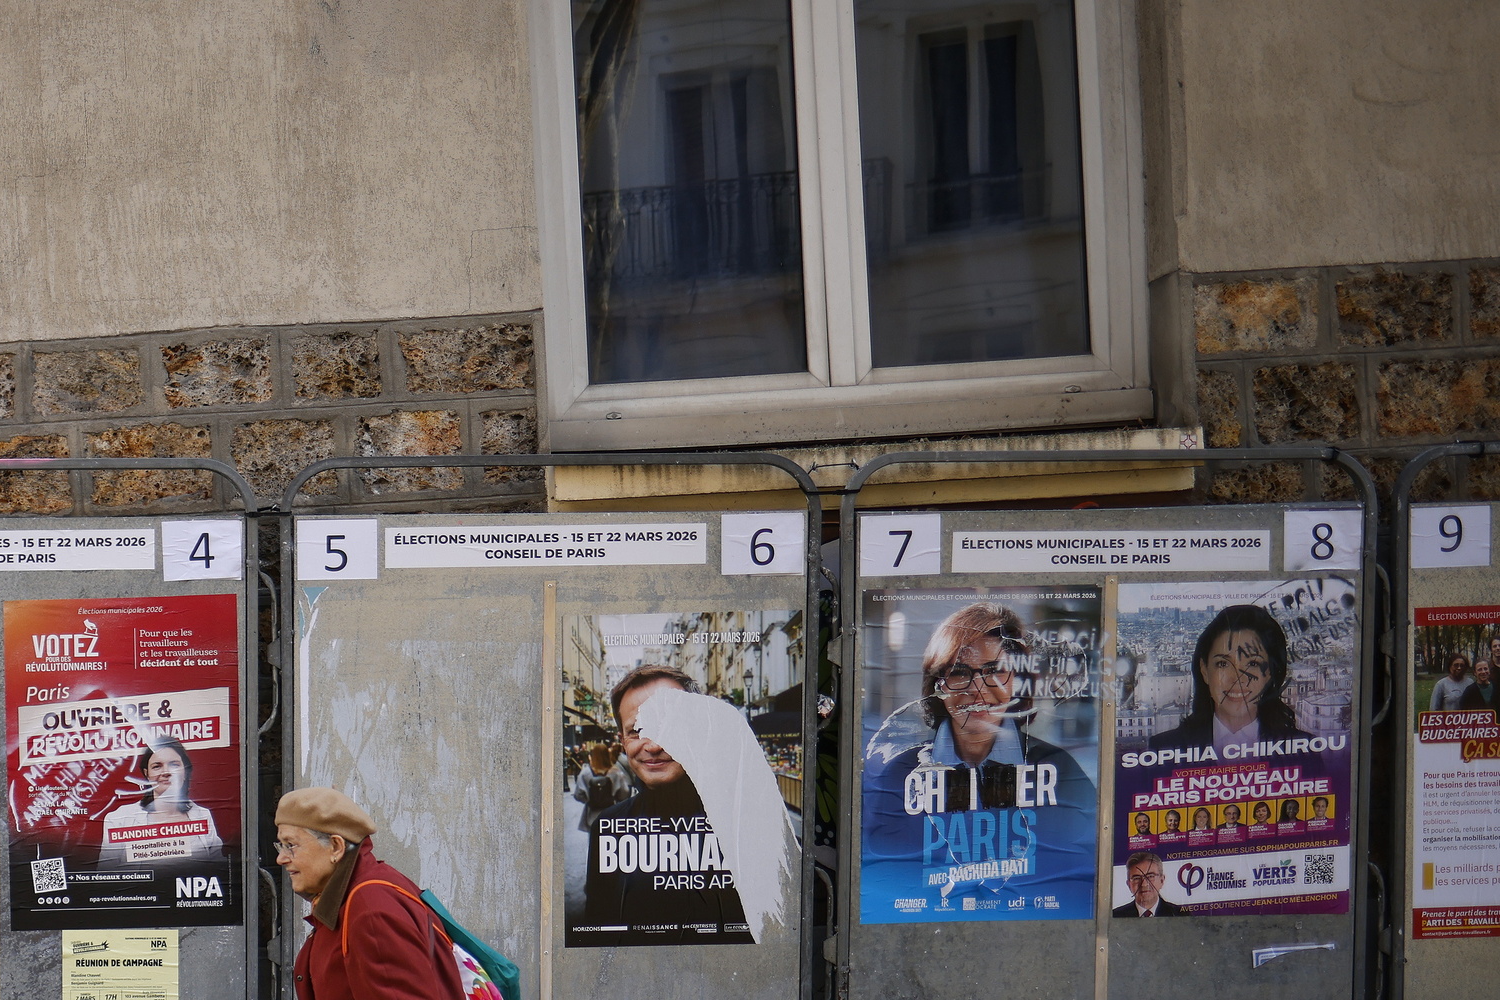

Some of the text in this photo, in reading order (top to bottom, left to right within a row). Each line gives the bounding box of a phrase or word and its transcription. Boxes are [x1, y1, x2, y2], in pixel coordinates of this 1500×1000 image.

[394, 531, 697, 545] ÉLECTIONS MUNICIPALES 15 ET 22 MARS 2026
[1439, 515, 1462, 552] 9
[22, 538, 35, 548] 15
[39, 537, 53, 548] ET
[57, 537, 72, 547] 22
[75, 537, 111, 547] MARS
[115, 537, 146, 547] 2026
[749, 528, 775, 565] 6
[962, 537, 1261, 550] ÉLECTIONS MUNICIPALES 15 ET 22 MARS 2026
[1310, 523, 1334, 560] 8
[189, 532, 215, 569] 4
[324, 534, 348, 571] 5
[485, 548, 605, 560] CONSEIL DE PARIS
[889, 530, 913, 568] 7
[18, 553, 56, 563] PARIS
[1051, 554, 1170, 565] CONSEIL DE PARIS
[163, 630, 178, 639] que
[32, 635, 99, 658] VOTEZ
[140, 639, 188, 647] travailleurs
[26, 661, 102, 672] RÉVOLUTIONNAIRES
[140, 658, 218, 667] décident de tout
[26, 685, 70, 702] Paris
[1421, 713, 1492, 726] LES COUPES
[1421, 726, 1498, 740] BUDGÉTAIRES
[1122, 735, 1346, 768] SOPHIA CHIKIROU
[1158, 768, 1299, 793] LE NOUVEAU
[1442, 772, 1455, 780] que
[1135, 780, 1328, 808] PARIS POPULAIRE
[112, 823, 205, 841] BLANDINE CHAUVEL
[923, 810, 1036, 865] PARIS
[1253, 866, 1296, 880] VERTS
[1436, 864, 1493, 873] Les milliards
[654, 875, 737, 890] PARIS AP
[929, 874, 947, 885] AVEC
[1207, 872, 1234, 881] FRANCE
[1253, 878, 1295, 887] POPULAIRES
[176, 877, 222, 898] NPA
[90, 895, 156, 903] npa-revolutionnaires.org
[1008, 897, 1025, 908] udi
[76, 958, 108, 967] RÉUNION
